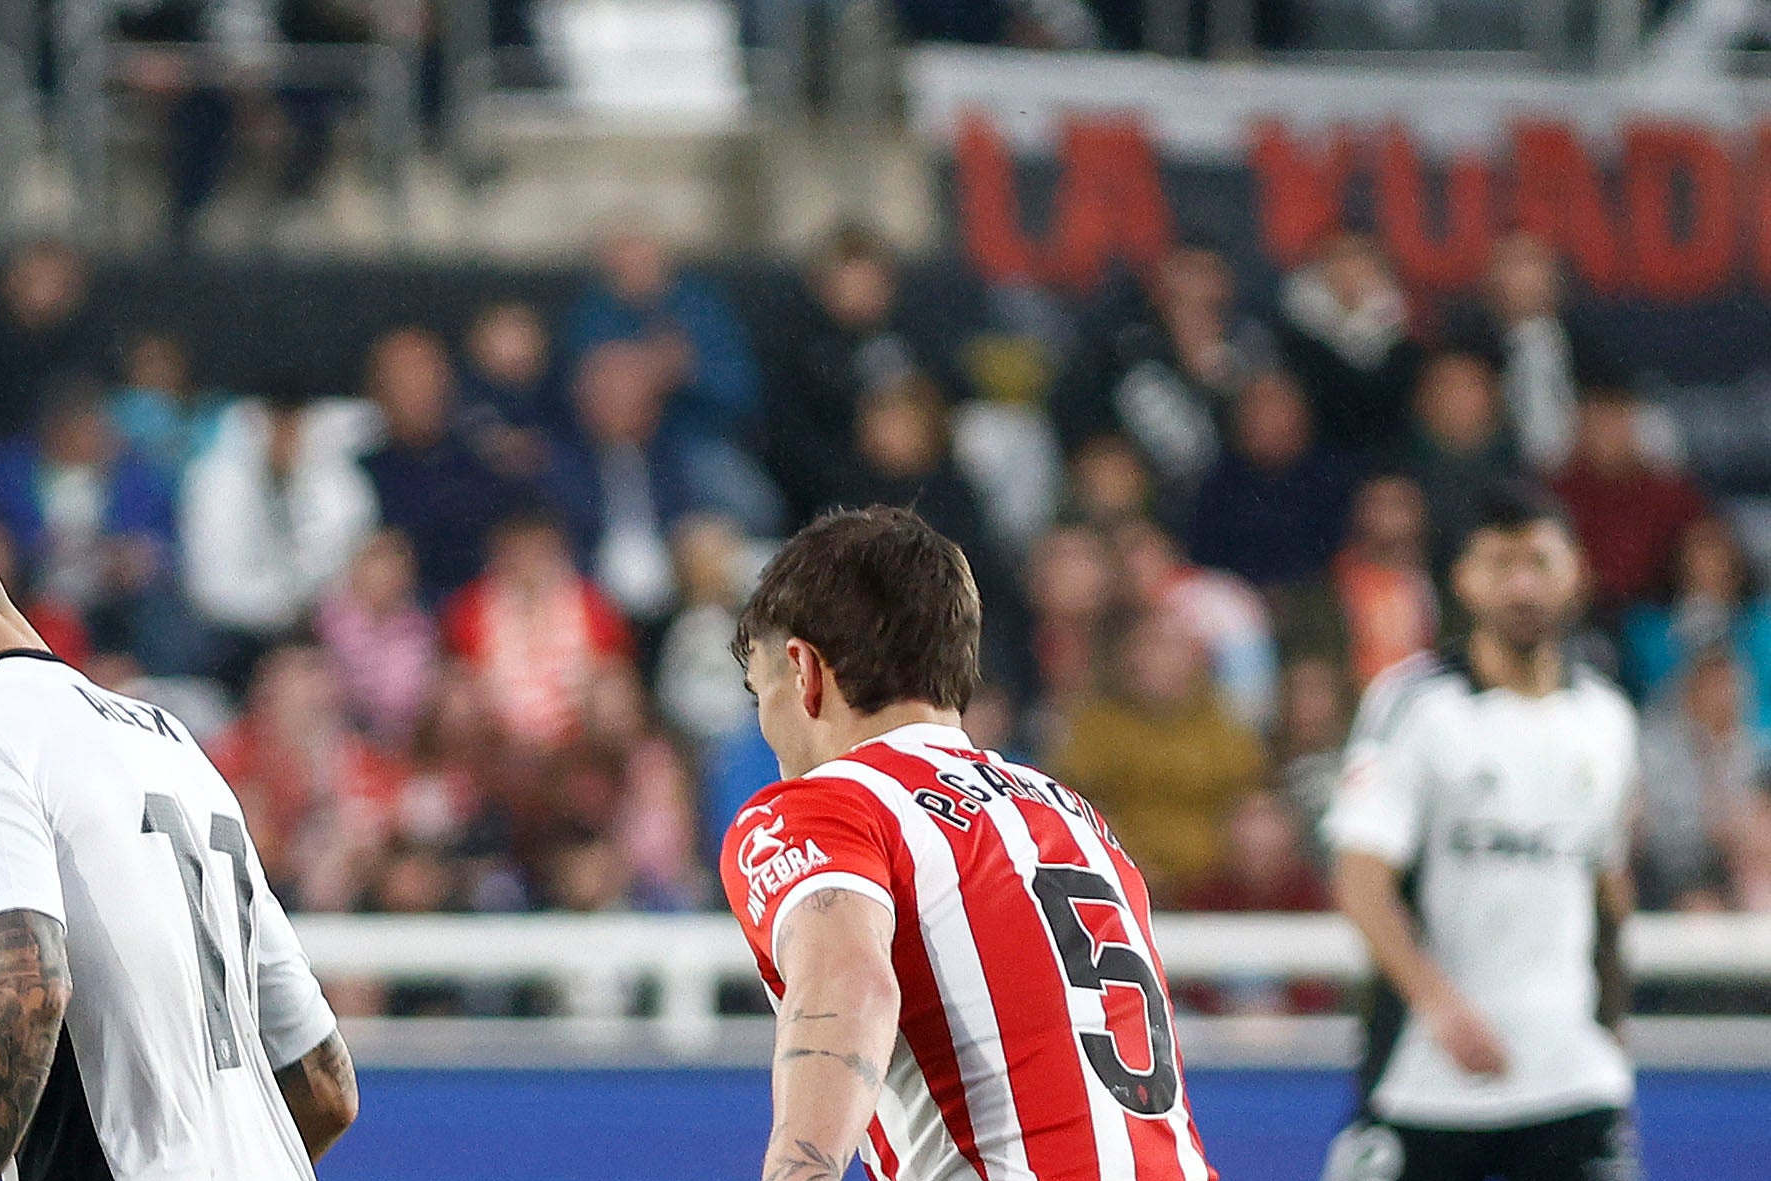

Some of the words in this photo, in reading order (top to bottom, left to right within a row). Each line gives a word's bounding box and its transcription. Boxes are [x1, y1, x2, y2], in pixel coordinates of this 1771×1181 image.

[950, 102, 1174, 294] LA
[71, 684, 183, 744] ALEX
[140, 791, 257, 1072] 11
[1032, 866, 1178, 1116] 5
